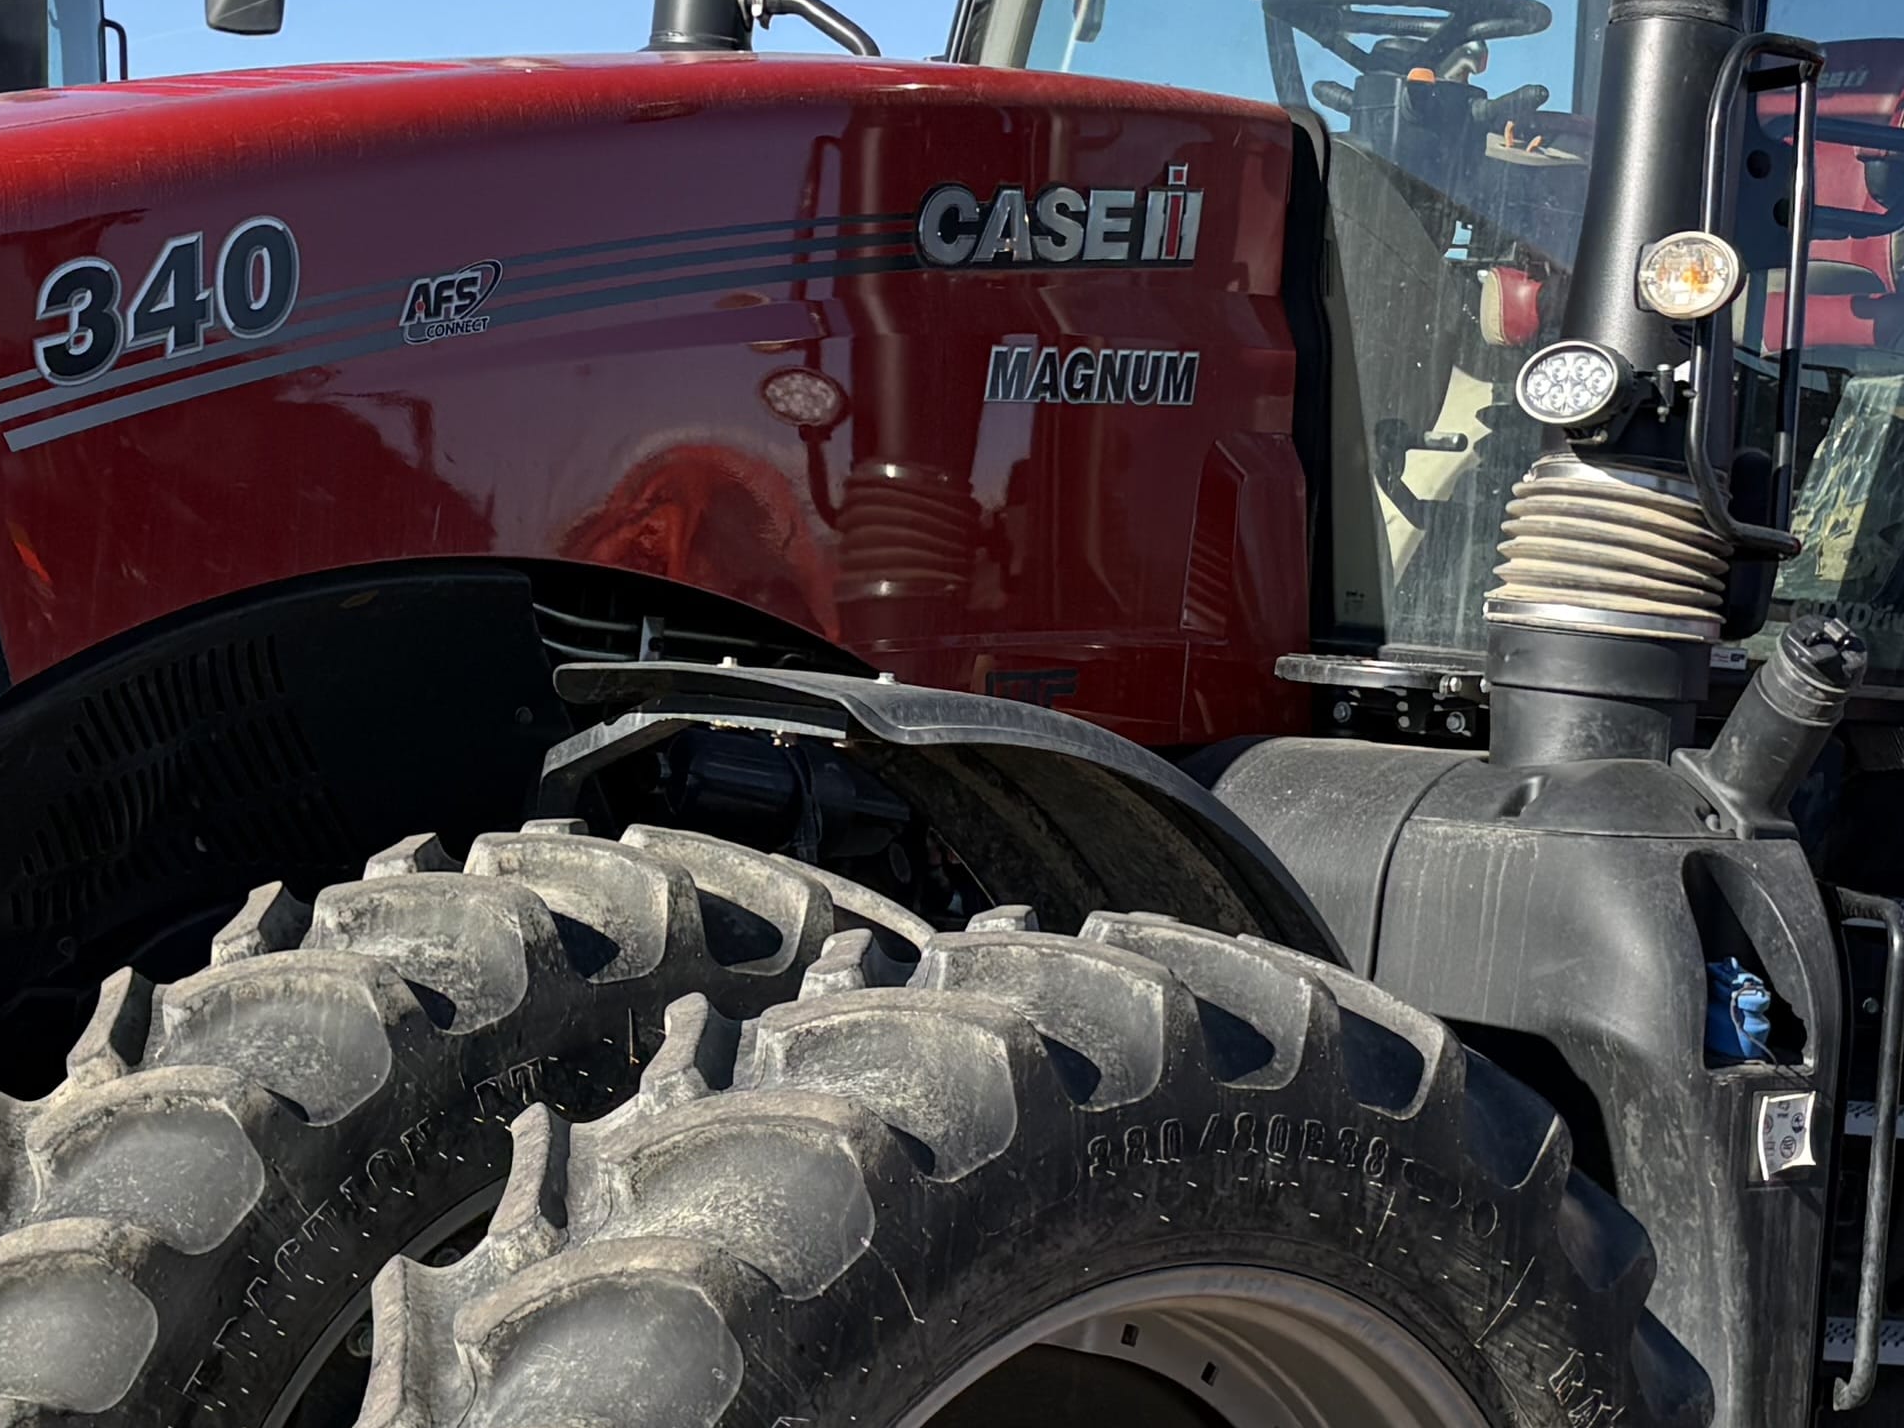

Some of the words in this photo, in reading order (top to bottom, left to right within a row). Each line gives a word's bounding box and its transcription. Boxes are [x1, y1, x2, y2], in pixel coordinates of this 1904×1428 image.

[917, 184, 1136, 266] CASE
[32, 215, 301, 389] 340
[399, 269, 483, 326] AFS
[425, 315, 490, 340] CONNECT
[984, 344, 1200, 406] MAGNUM
